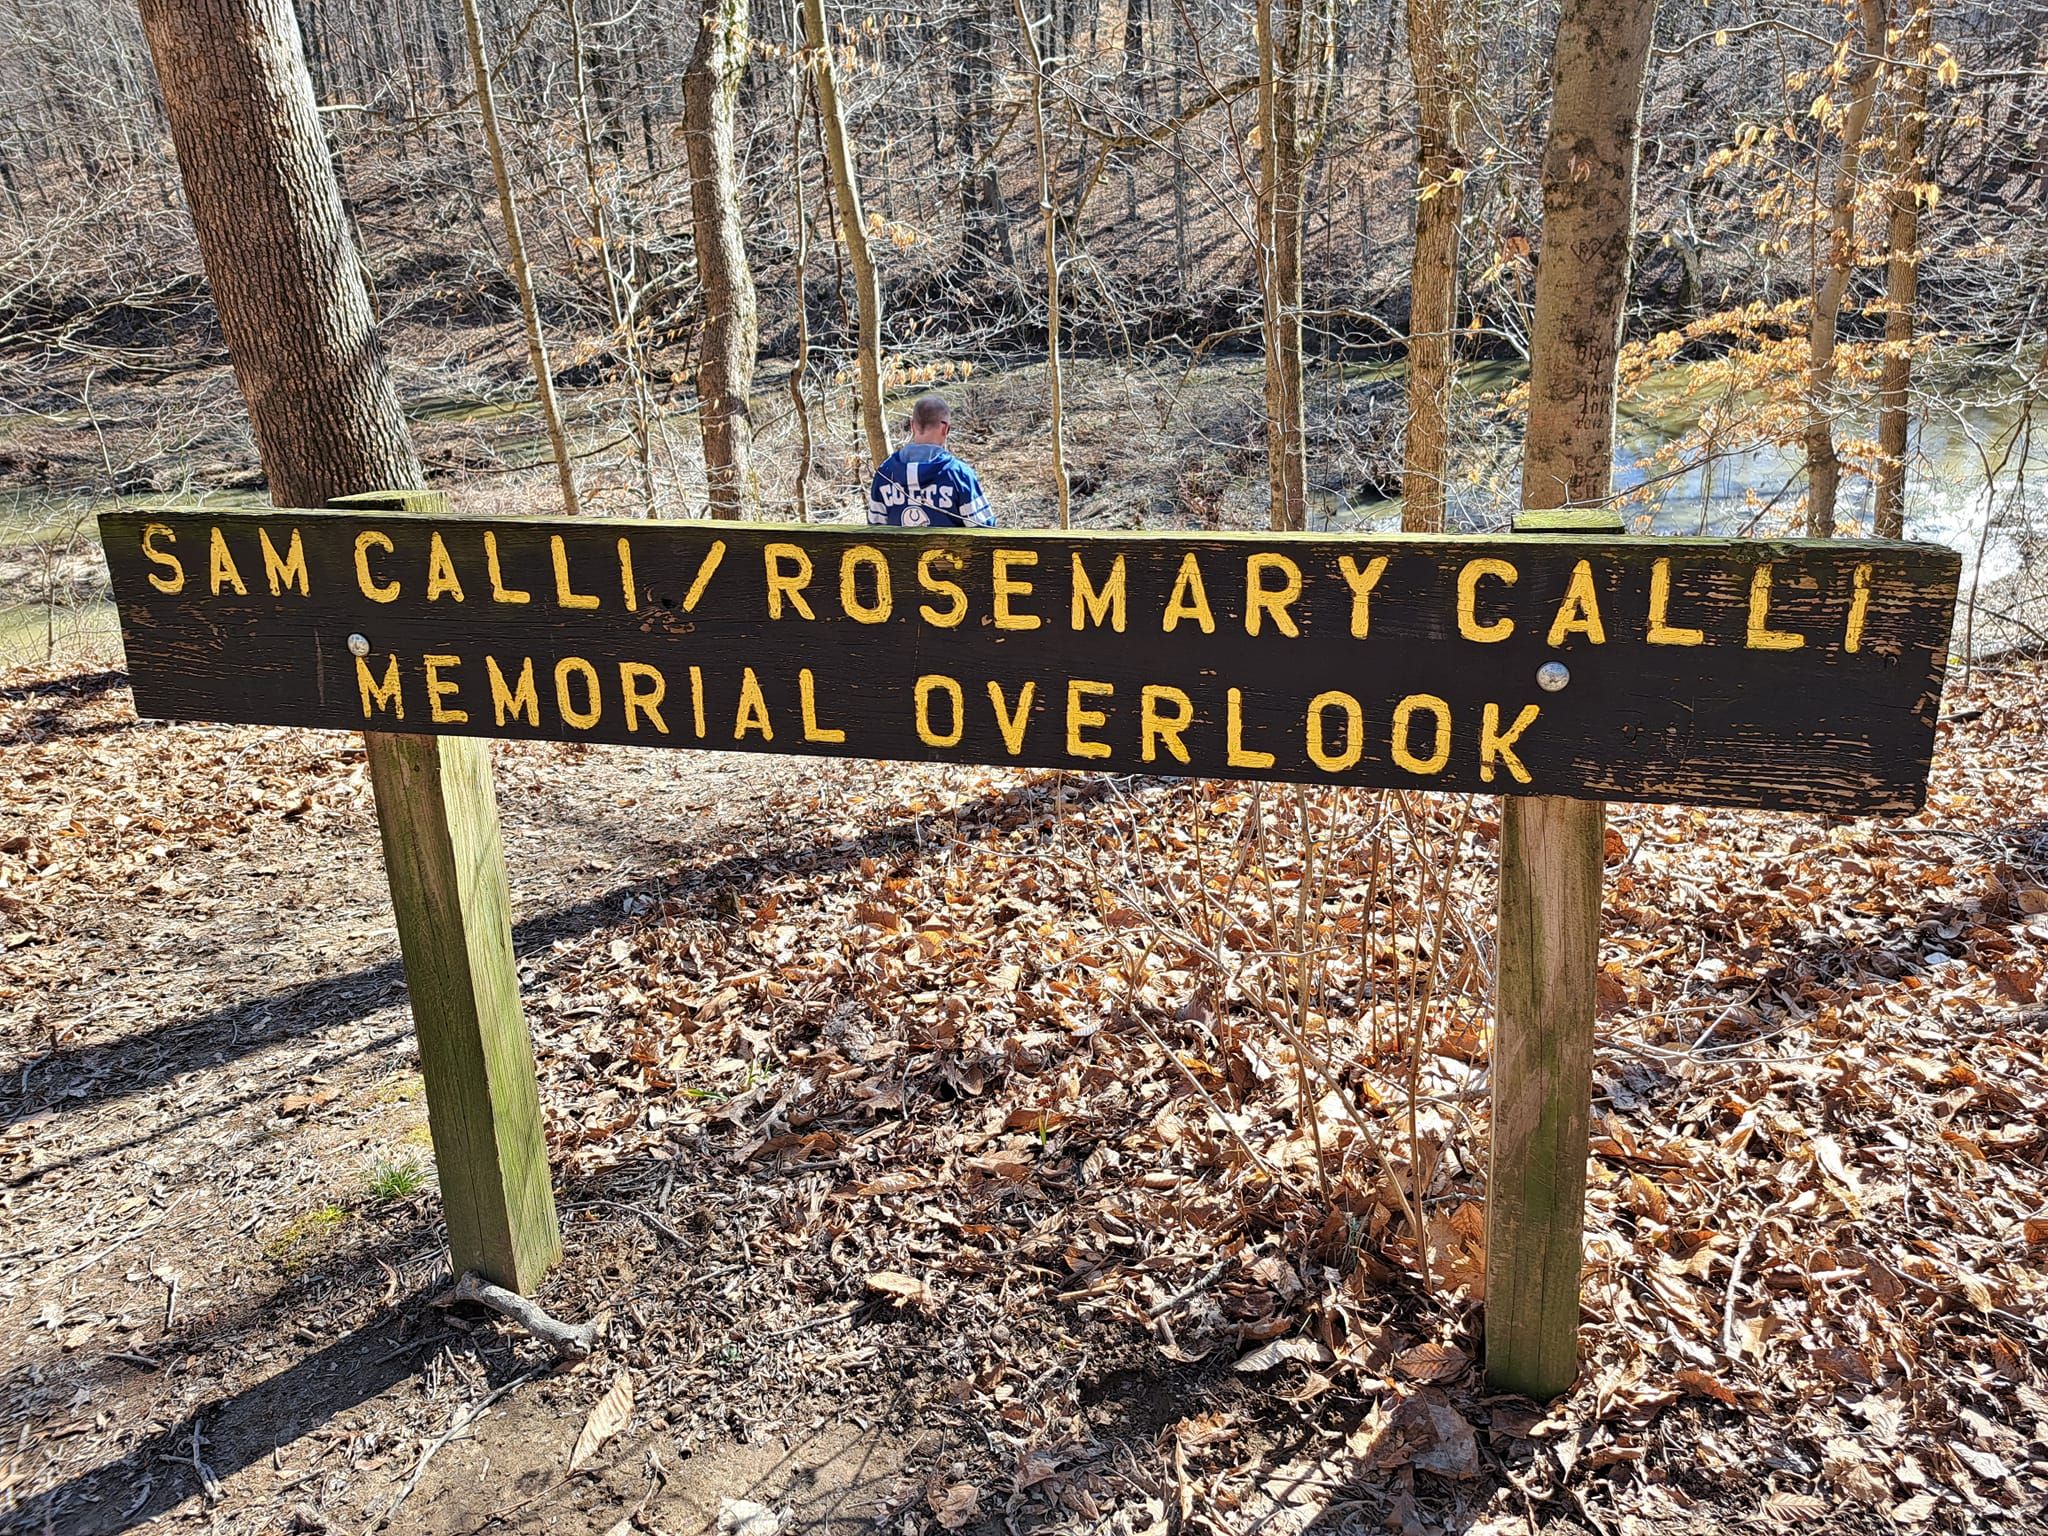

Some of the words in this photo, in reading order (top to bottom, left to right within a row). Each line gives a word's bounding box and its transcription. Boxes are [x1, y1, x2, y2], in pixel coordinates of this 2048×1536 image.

[879, 482, 954, 508] COLTS
[142, 521, 310, 597] SAM
[1456, 557, 1873, 654] CALLI
[356, 654, 846, 743] MEMORIAL
[913, 674, 1541, 784] OVERLOOK
